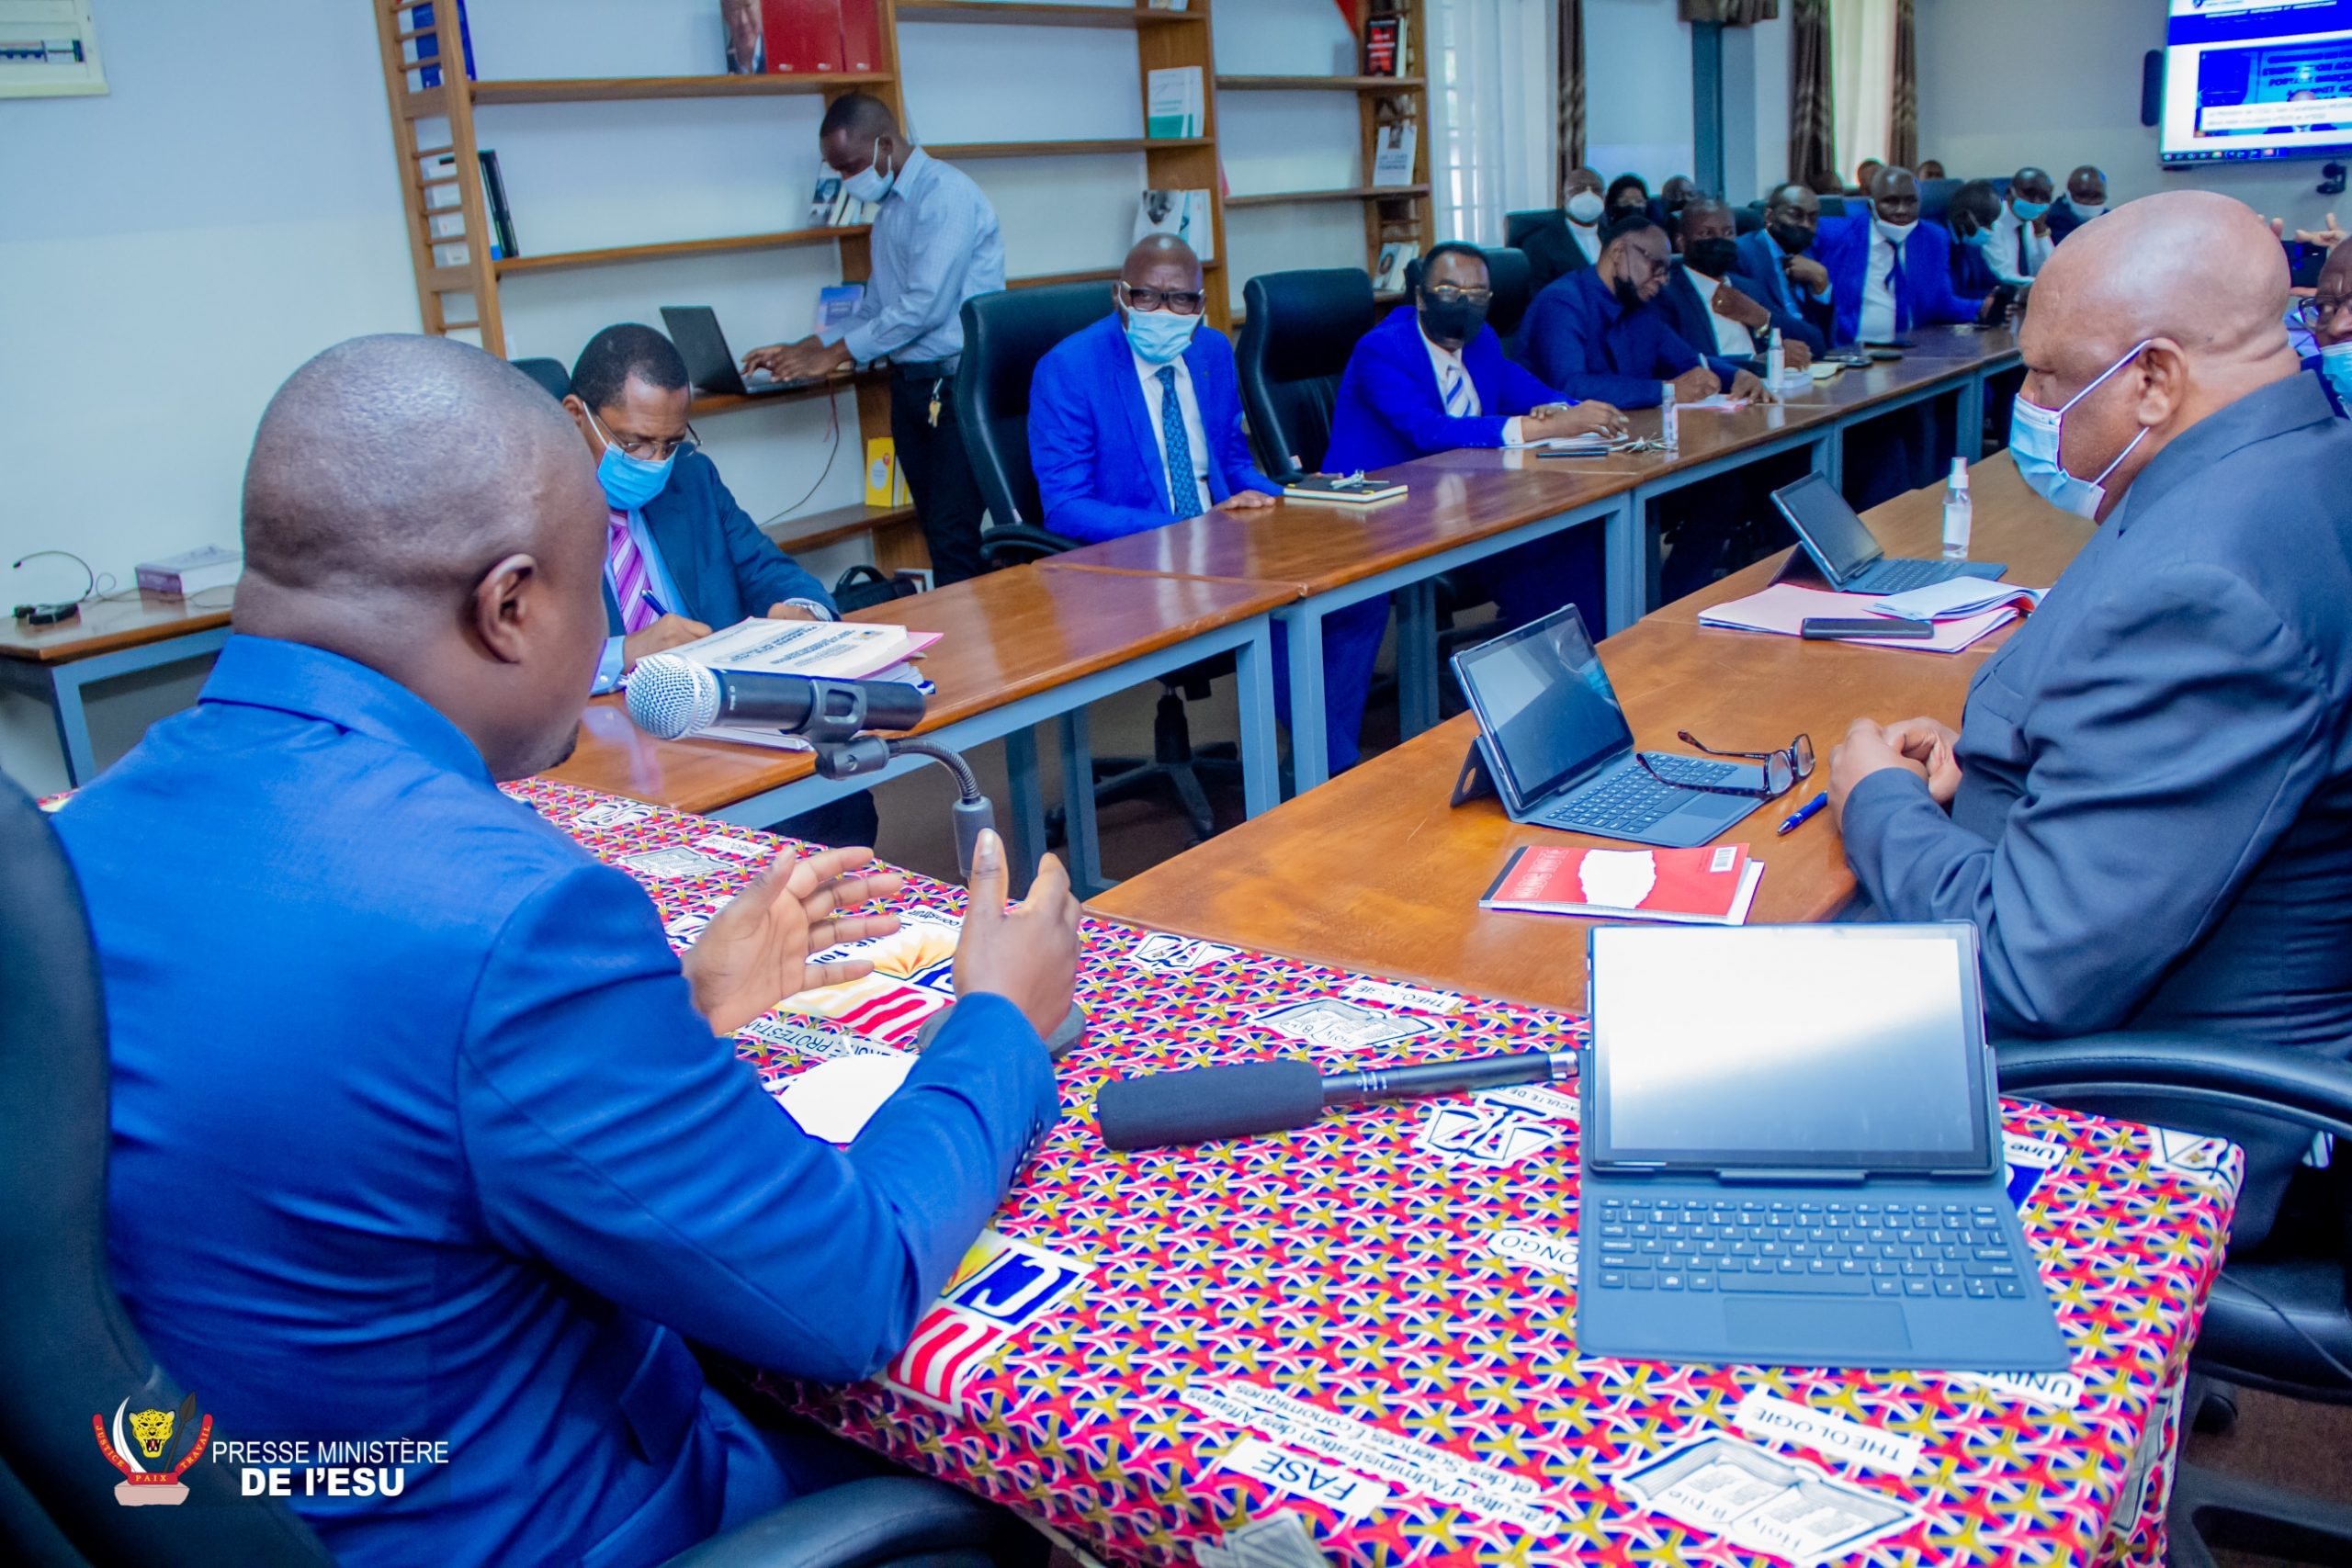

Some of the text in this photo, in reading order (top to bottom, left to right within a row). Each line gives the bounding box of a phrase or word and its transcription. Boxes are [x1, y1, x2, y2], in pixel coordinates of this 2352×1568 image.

[1500, 1235, 1579, 1266] ONGO
[1975, 1371, 2073, 1397] UNIV
[1187, 1390, 1259, 1423] Affaires
[1261, 1417, 1297, 1436] des
[1752, 1406, 1901, 1462] THEOLOGIE
[1371, 1432, 1460, 1473] Sciences
[1251, 1450, 1358, 1501] FASE
[1469, 1465, 1508, 1486] des
[1510, 1480, 1533, 1495] et
